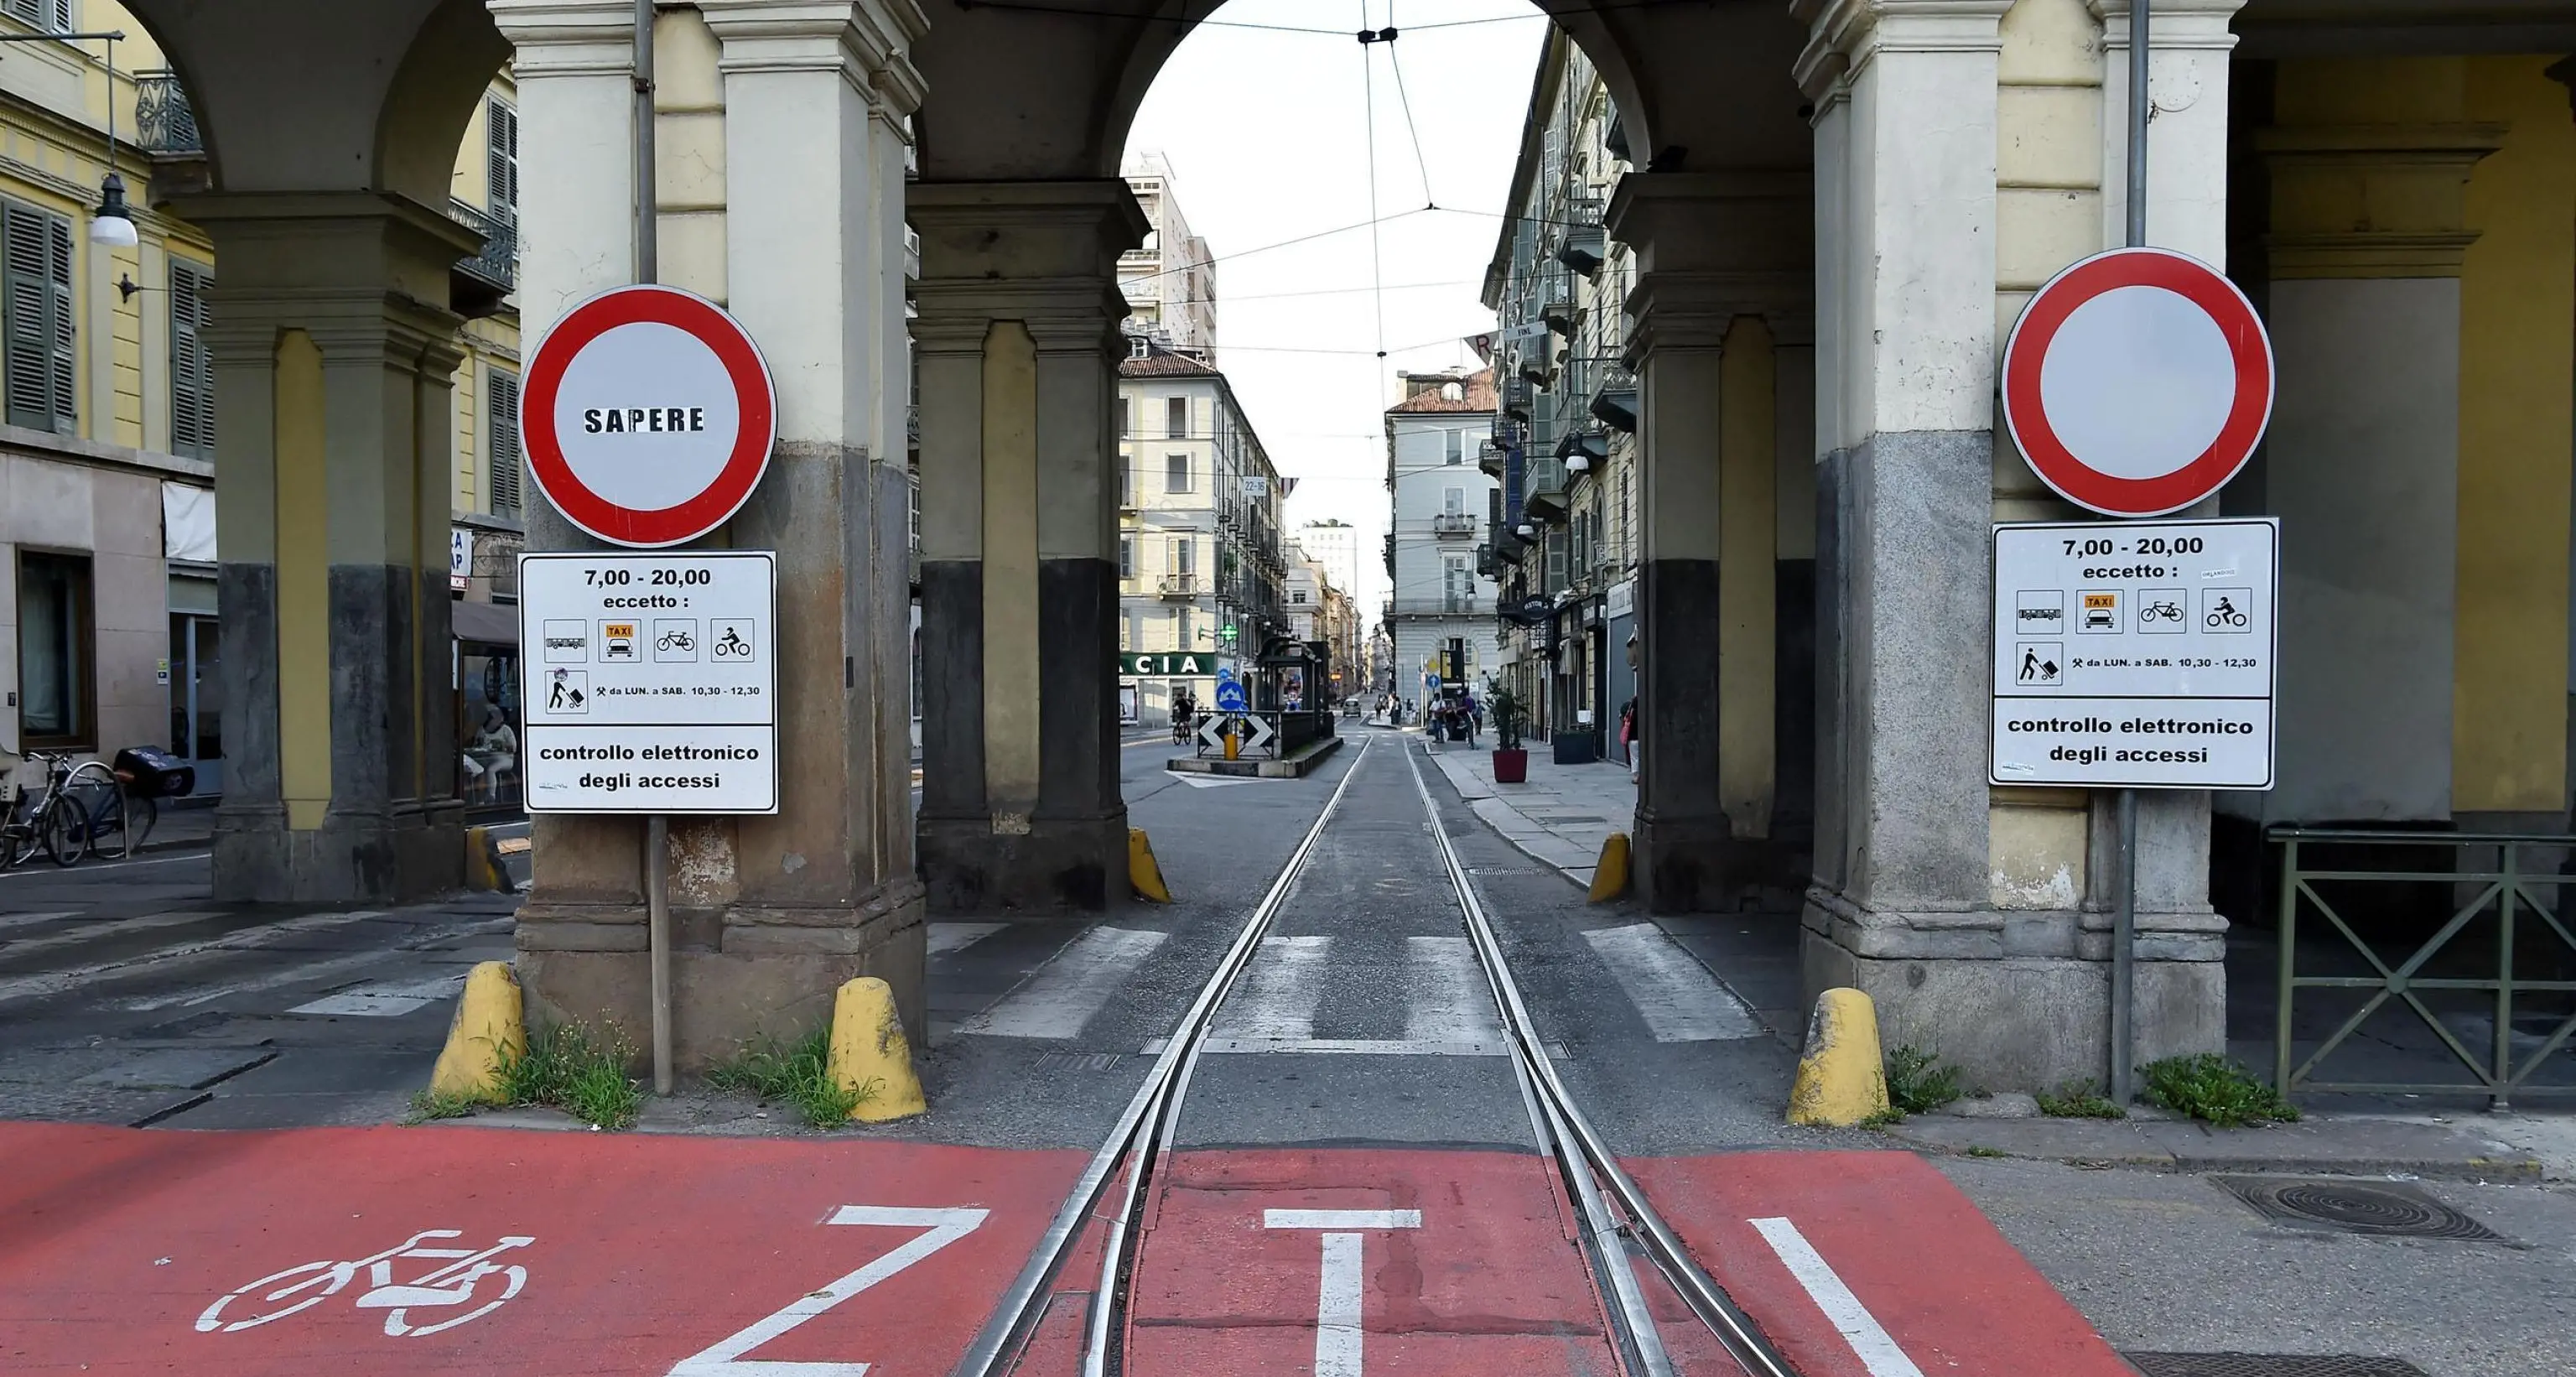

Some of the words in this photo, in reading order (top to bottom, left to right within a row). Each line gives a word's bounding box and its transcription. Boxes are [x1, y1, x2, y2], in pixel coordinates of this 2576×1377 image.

[584, 408, 704, 433] SAPERE
[2063, 538, 2113, 559] 7,00
[2136, 537, 2204, 558] 20,00
[584, 569, 631, 589] 7,00
[651, 569, 711, 589] 20,00
[2082, 564, 2165, 579] eccetto
[603, 595, 678, 608] eccetto
[2088, 598, 2112, 606] TAXI
[609, 627, 631, 636] TAXI
[2086, 658, 2101, 668] da
[2103, 658, 2132, 668] LUN.
[2145, 658, 2173, 668] SAB.
[2178, 657, 2212, 669] 10,30
[2223, 657, 2257, 668] 12,30
[609, 687, 622, 695] da
[625, 687, 649, 695] LUN.
[662, 687, 686, 695] SAB.
[691, 687, 721, 697] 10,30
[730, 686, 761, 696] 12,30
[2007, 717, 2112, 734] controllo
[2120, 718, 2254, 735] elettronico
[540, 745, 635, 761] controllo
[641, 745, 759, 761] elettronico
[2049, 745, 2107, 766] degli
[2115, 747, 2208, 763] accessi
[579, 772, 631, 792] degli
[638, 772, 719, 788] accessi
